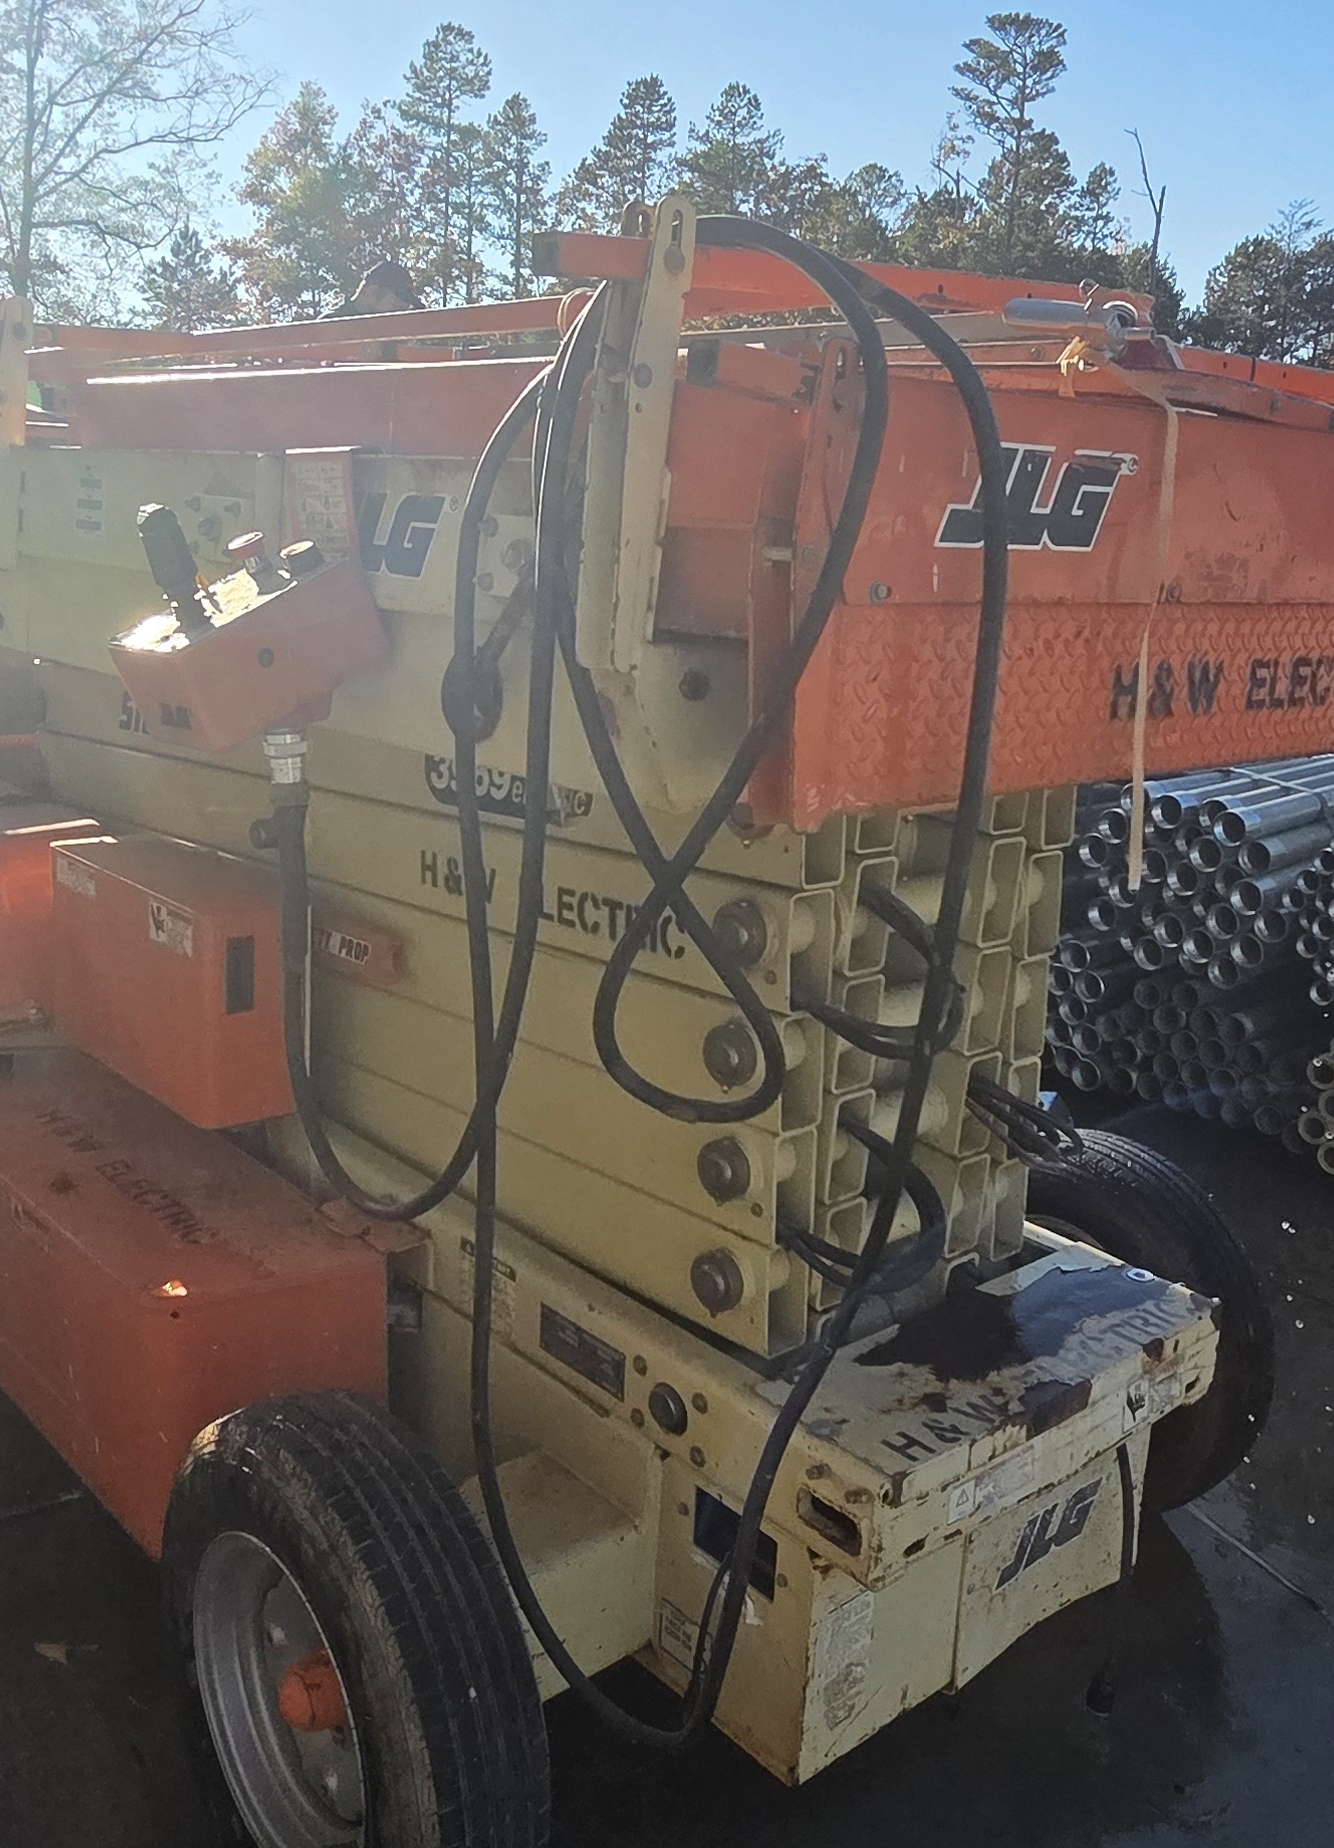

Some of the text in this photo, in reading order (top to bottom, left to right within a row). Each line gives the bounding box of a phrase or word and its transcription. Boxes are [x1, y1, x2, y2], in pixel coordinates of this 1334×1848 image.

[361, 490, 447, 579] LG
[934, 441, 1120, 551] JLG
[338, 936, 371, 963] PROP
[994, 1476, 1104, 1592] JLG
